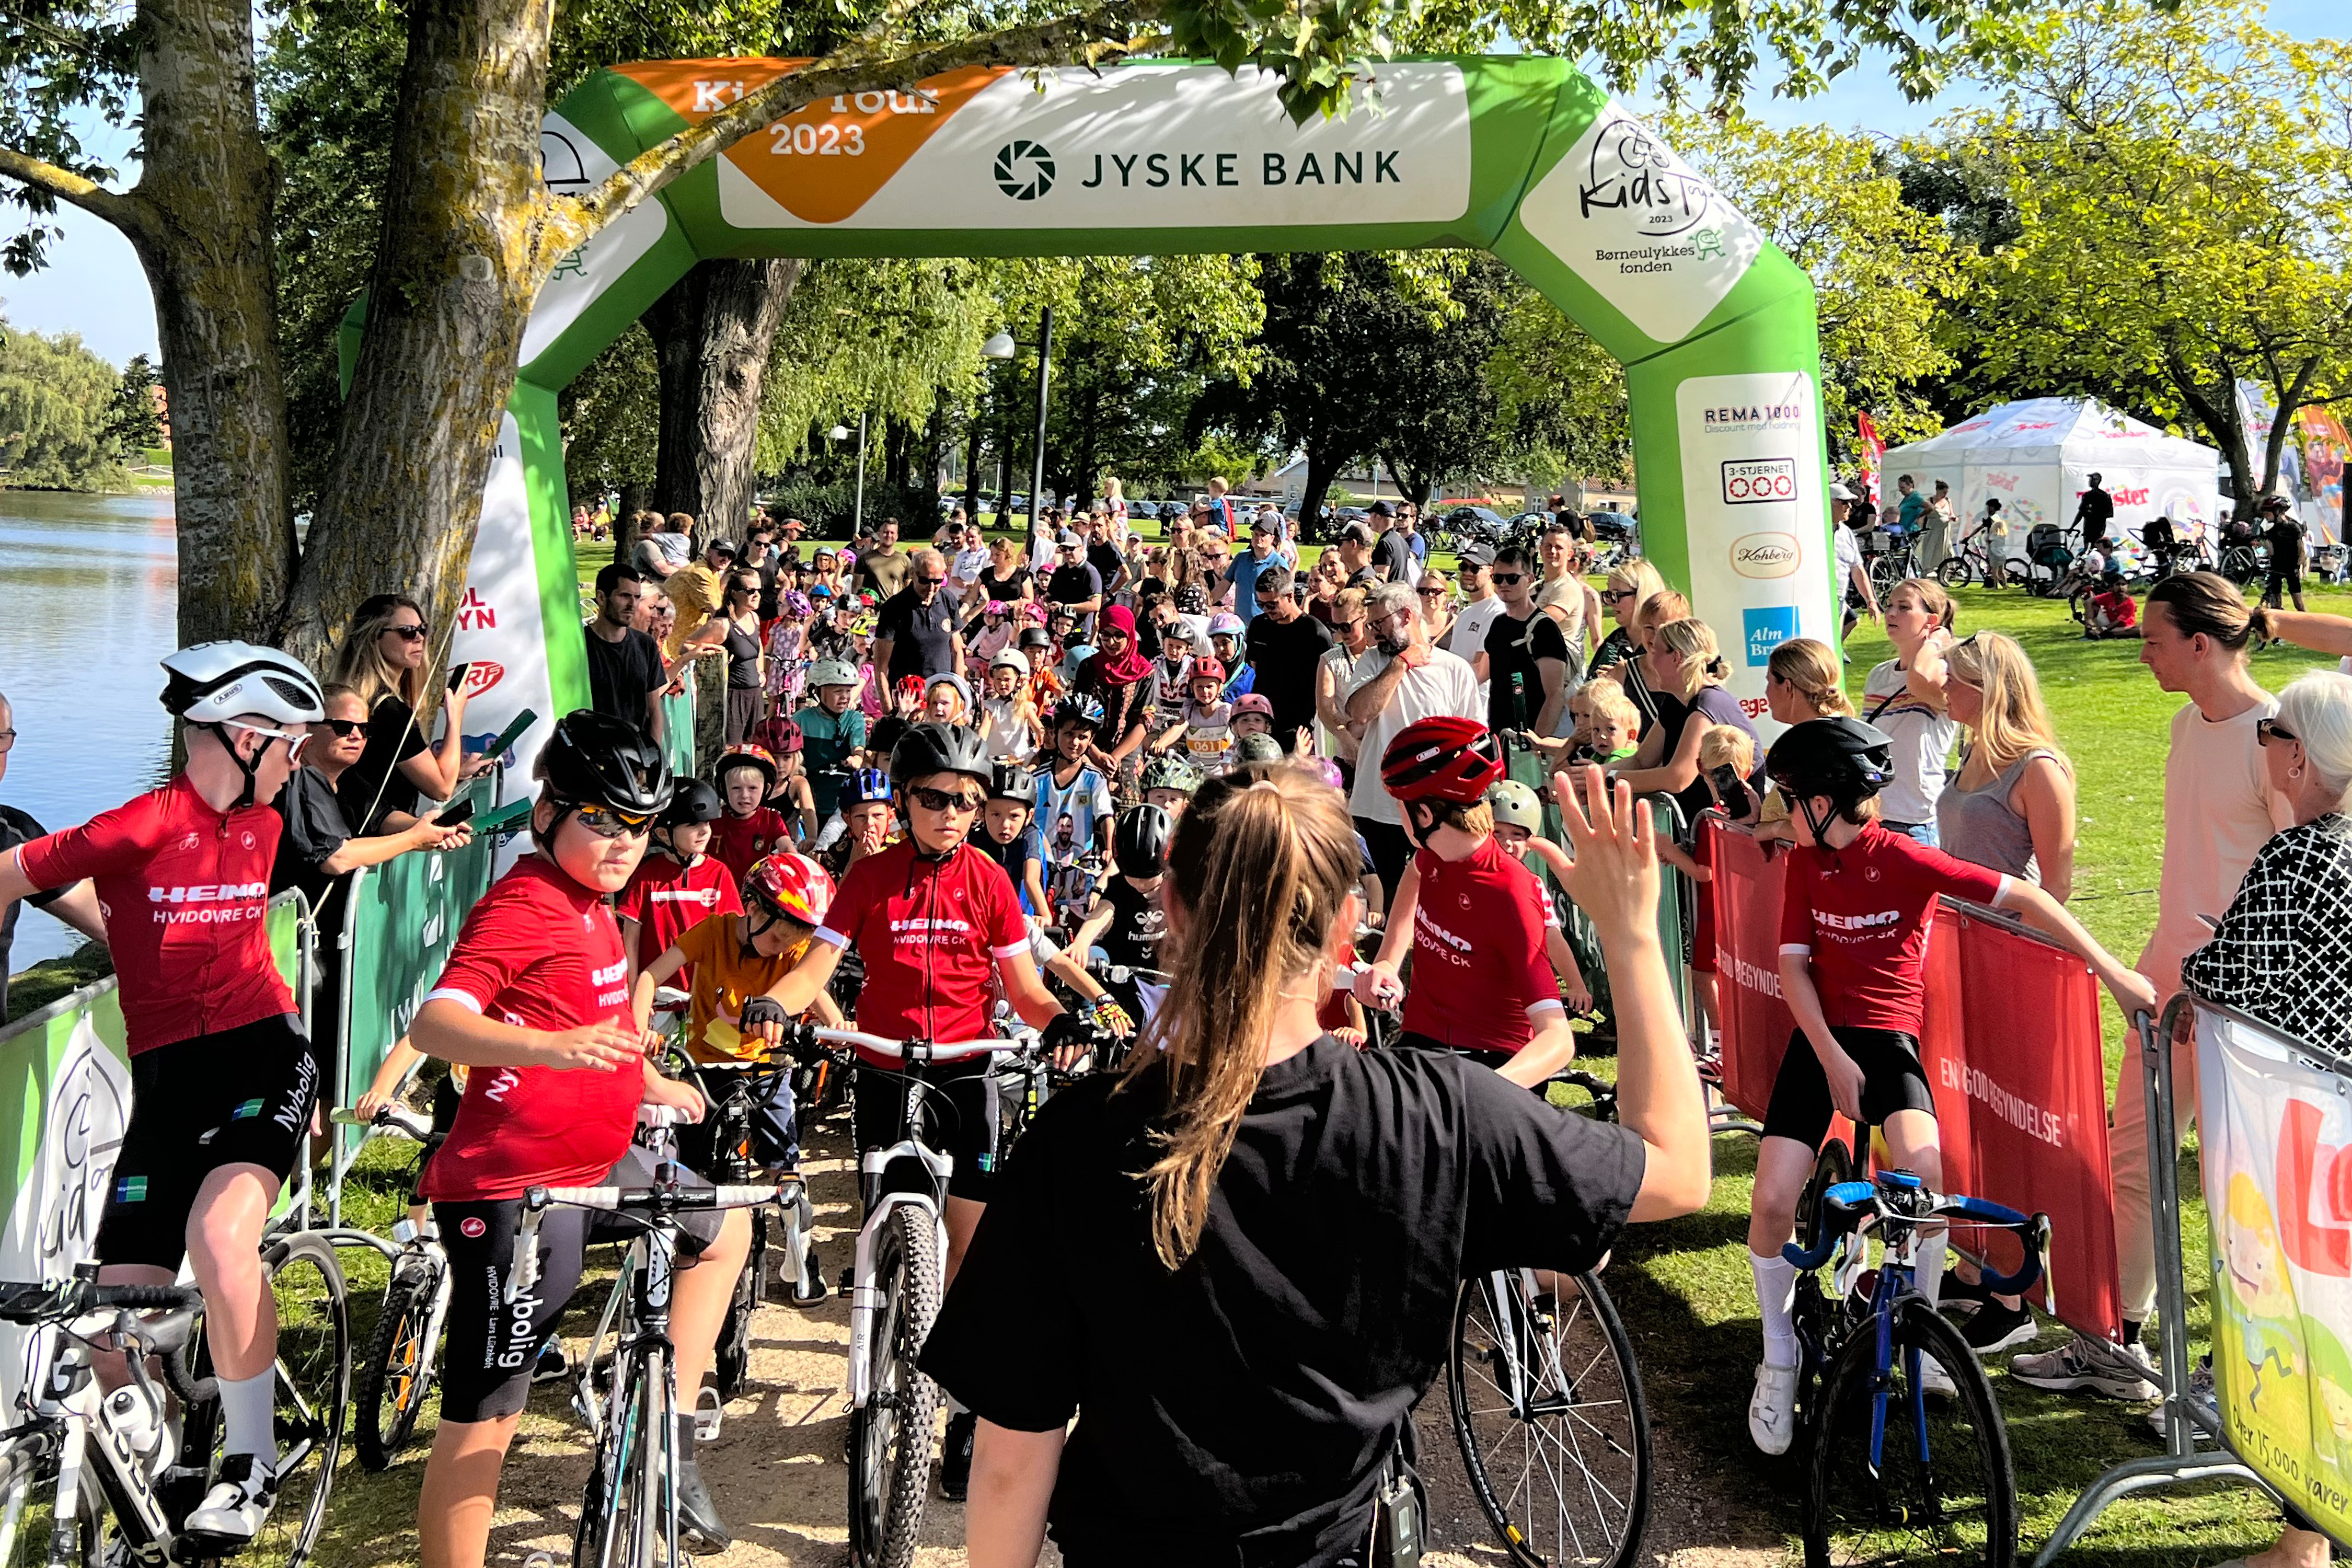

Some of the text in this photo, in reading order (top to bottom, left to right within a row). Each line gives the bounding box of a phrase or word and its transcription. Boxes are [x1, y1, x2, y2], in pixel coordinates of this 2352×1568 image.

[770, 123, 866, 156] 2023
[1081, 151, 1401, 188] JYSKE BANK
[1579, 169, 1671, 218] Kids
[1649, 215, 1673, 224] 2023
[1595, 246, 1695, 262] Børneulykkes
[1620, 261, 1673, 274] fonden
[1705, 406, 1800, 423] REMA 1000
[1705, 424, 1745, 433] Discount
[1748, 422, 1767, 431] med
[1728, 465, 1790, 476] 3-STJERNET
[1738, 547, 1794, 563] Kohberg
[1750, 627, 1783, 642] Alm
[153, 906, 263, 924] HVIDOVRE CK
[951, 936, 966, 945] CK
[1451, 954, 1471, 967] CK
[1734, 958, 1783, 999] BEGYNDE
[273, 1051, 316, 1133] Nybolig
[1940, 1056, 2062, 1148] EN GOD BEGYNDELSE
[486, 1265, 500, 1311] HVIDOVRE
[498, 1258, 544, 1368] ybolig
[2233, 1403, 2348, 1515] Over 15.000 varer
